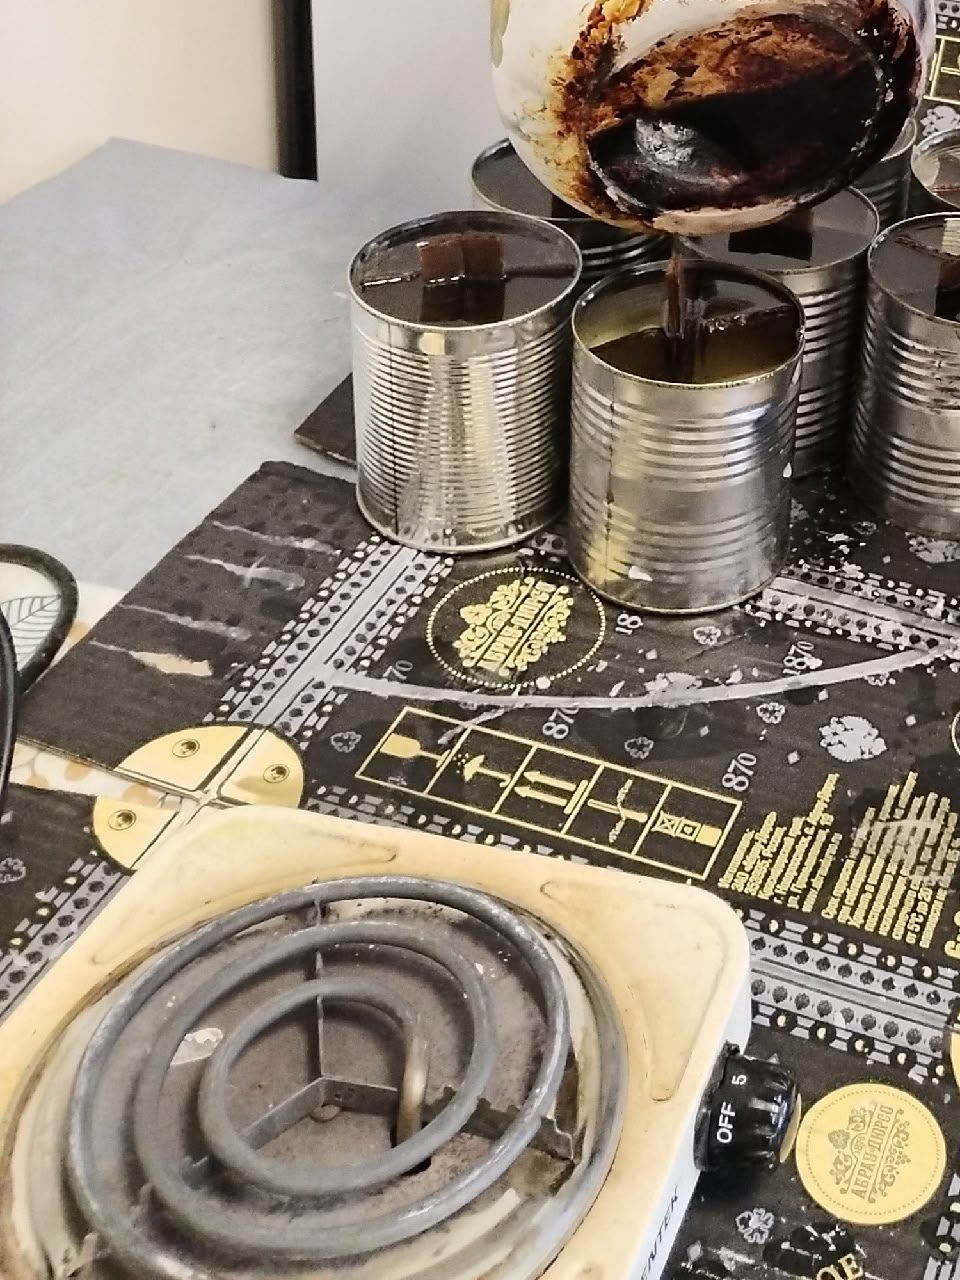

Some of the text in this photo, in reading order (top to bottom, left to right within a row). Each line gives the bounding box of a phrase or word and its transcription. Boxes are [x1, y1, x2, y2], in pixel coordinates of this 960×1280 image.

[722, 752, 757, 792] 870
[732, 1074, 747, 1087] 5
[716, 1101, 736, 1144] OFF
